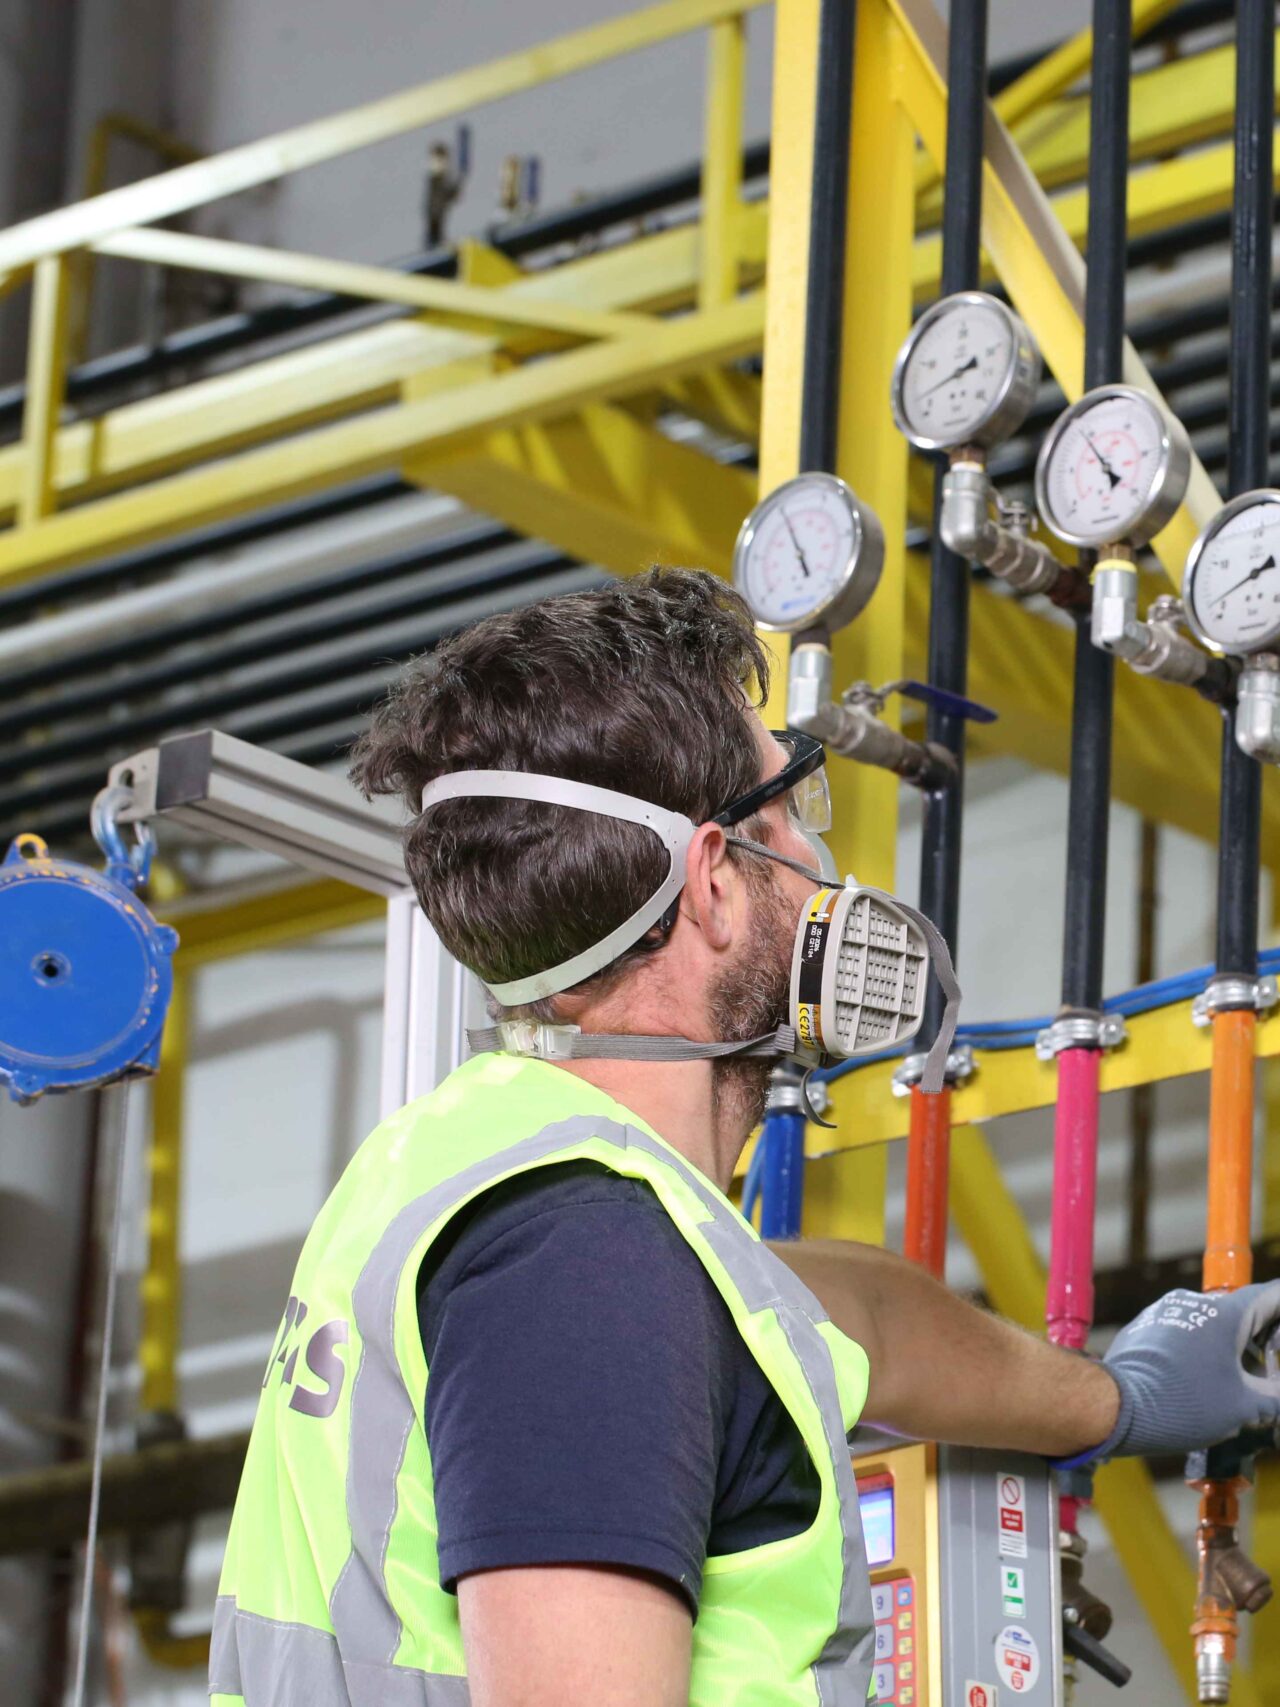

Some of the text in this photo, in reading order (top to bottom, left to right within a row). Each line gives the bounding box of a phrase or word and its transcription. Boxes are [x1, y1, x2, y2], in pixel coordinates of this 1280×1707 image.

[1201, 1303, 1218, 1318] 10
[1188, 1311, 1209, 1328] CE
[876, 1595, 884, 1611] 9
[877, 1634, 885, 1649] 6
[877, 1674, 885, 1689] 3
